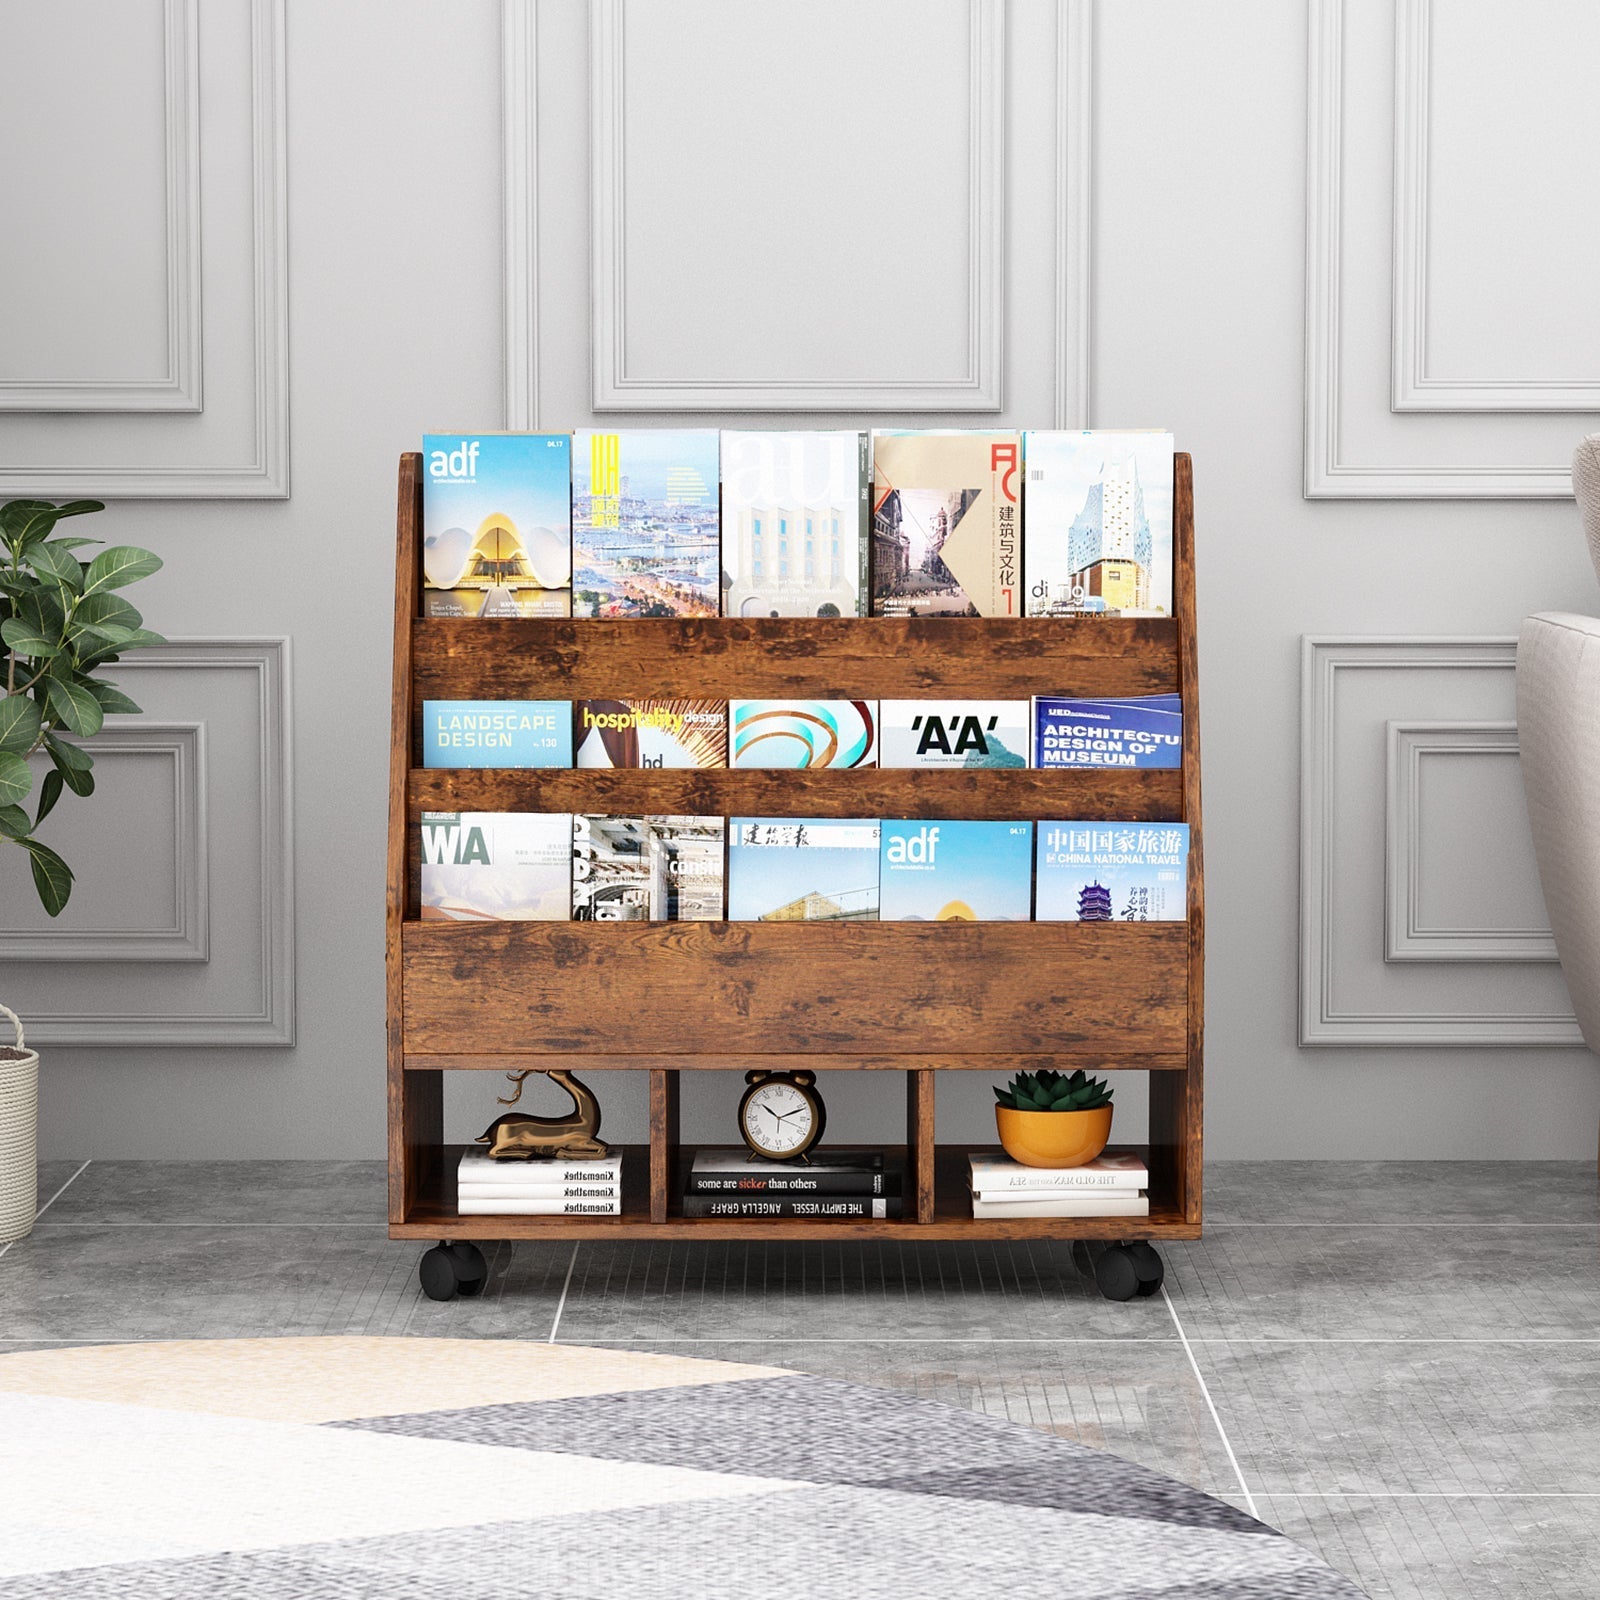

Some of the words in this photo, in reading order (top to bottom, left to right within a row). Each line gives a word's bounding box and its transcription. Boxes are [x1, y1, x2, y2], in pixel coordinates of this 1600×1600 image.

[429, 441, 480, 477] adf
[999, 506, 1015, 586] 建筑与文化
[438, 715, 556, 730] LANDSCAPE
[584, 707, 684, 733] hospitality
[684, 711, 723, 726] design
[438, 732, 512, 747] DESIGN
[541, 738, 558, 747] 130
[1043, 737, 1123, 752] DESIGN
[1129, 742, 1158, 754] OF
[1043, 750, 1136, 765] MUSEUM
[421, 825, 491, 865] WA
[887, 827, 939, 863] adf
[1047, 829, 1182, 854] 中国国家旅游
[1058, 854, 1091, 863] CHINA
[1094, 854, 1144, 864] NATIONAL
[1146, 855, 1181, 865] TRAVEL
[698, 1180, 721, 1189] some
[723, 1180, 737, 1189] are
[739, 1178, 767, 1189] sicker
[768, 1178, 788, 1189] than
[789, 1178, 817, 1189] others
[711, 1203, 739, 1214] GRAFF
[741, 1203, 781, 1214] ANGELLA
[792, 1203, 820, 1214] VESSEL
[821, 1203, 847, 1214] EMPTY
[848, 1204, 864, 1214] THE
